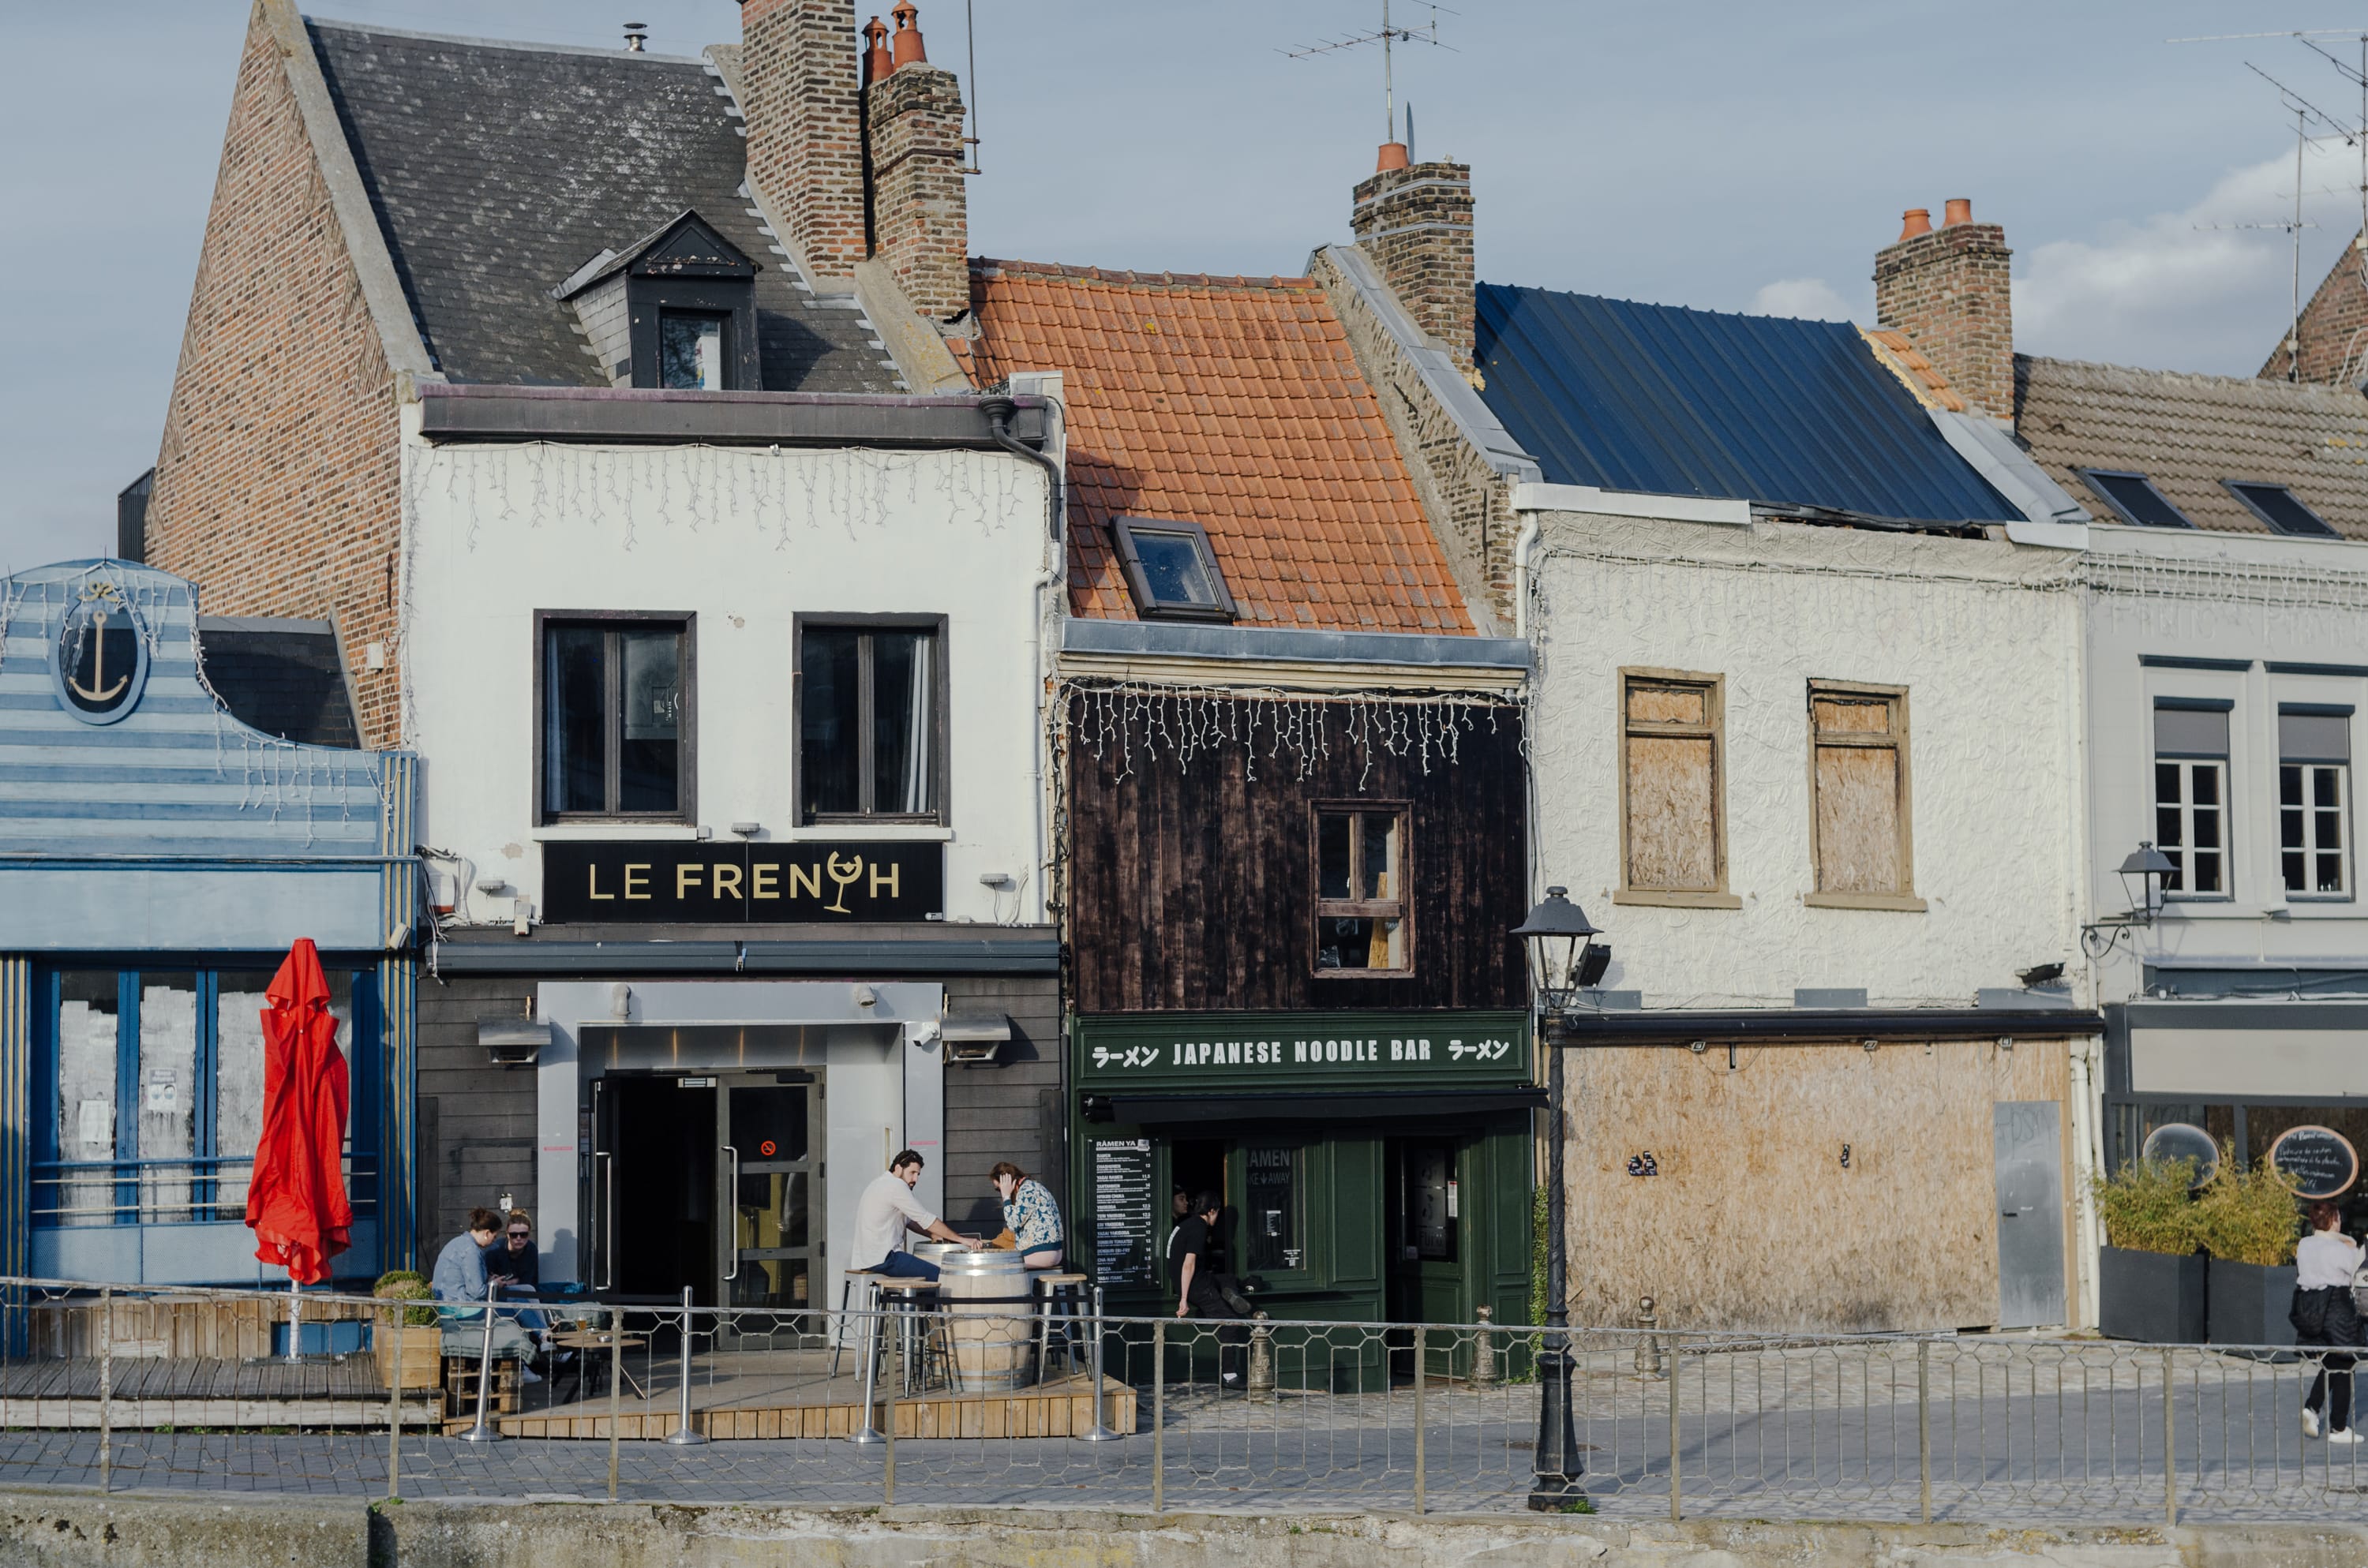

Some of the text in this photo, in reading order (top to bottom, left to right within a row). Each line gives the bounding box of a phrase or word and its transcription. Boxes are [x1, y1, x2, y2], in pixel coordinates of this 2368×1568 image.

[590, 863, 651, 899] LE
[1092, 1046, 1160, 1068] ラーメン
[1173, 1038, 1431, 1065] JAPANESE NOODLE BAR
[1448, 1039, 1510, 1061] ラーメン
